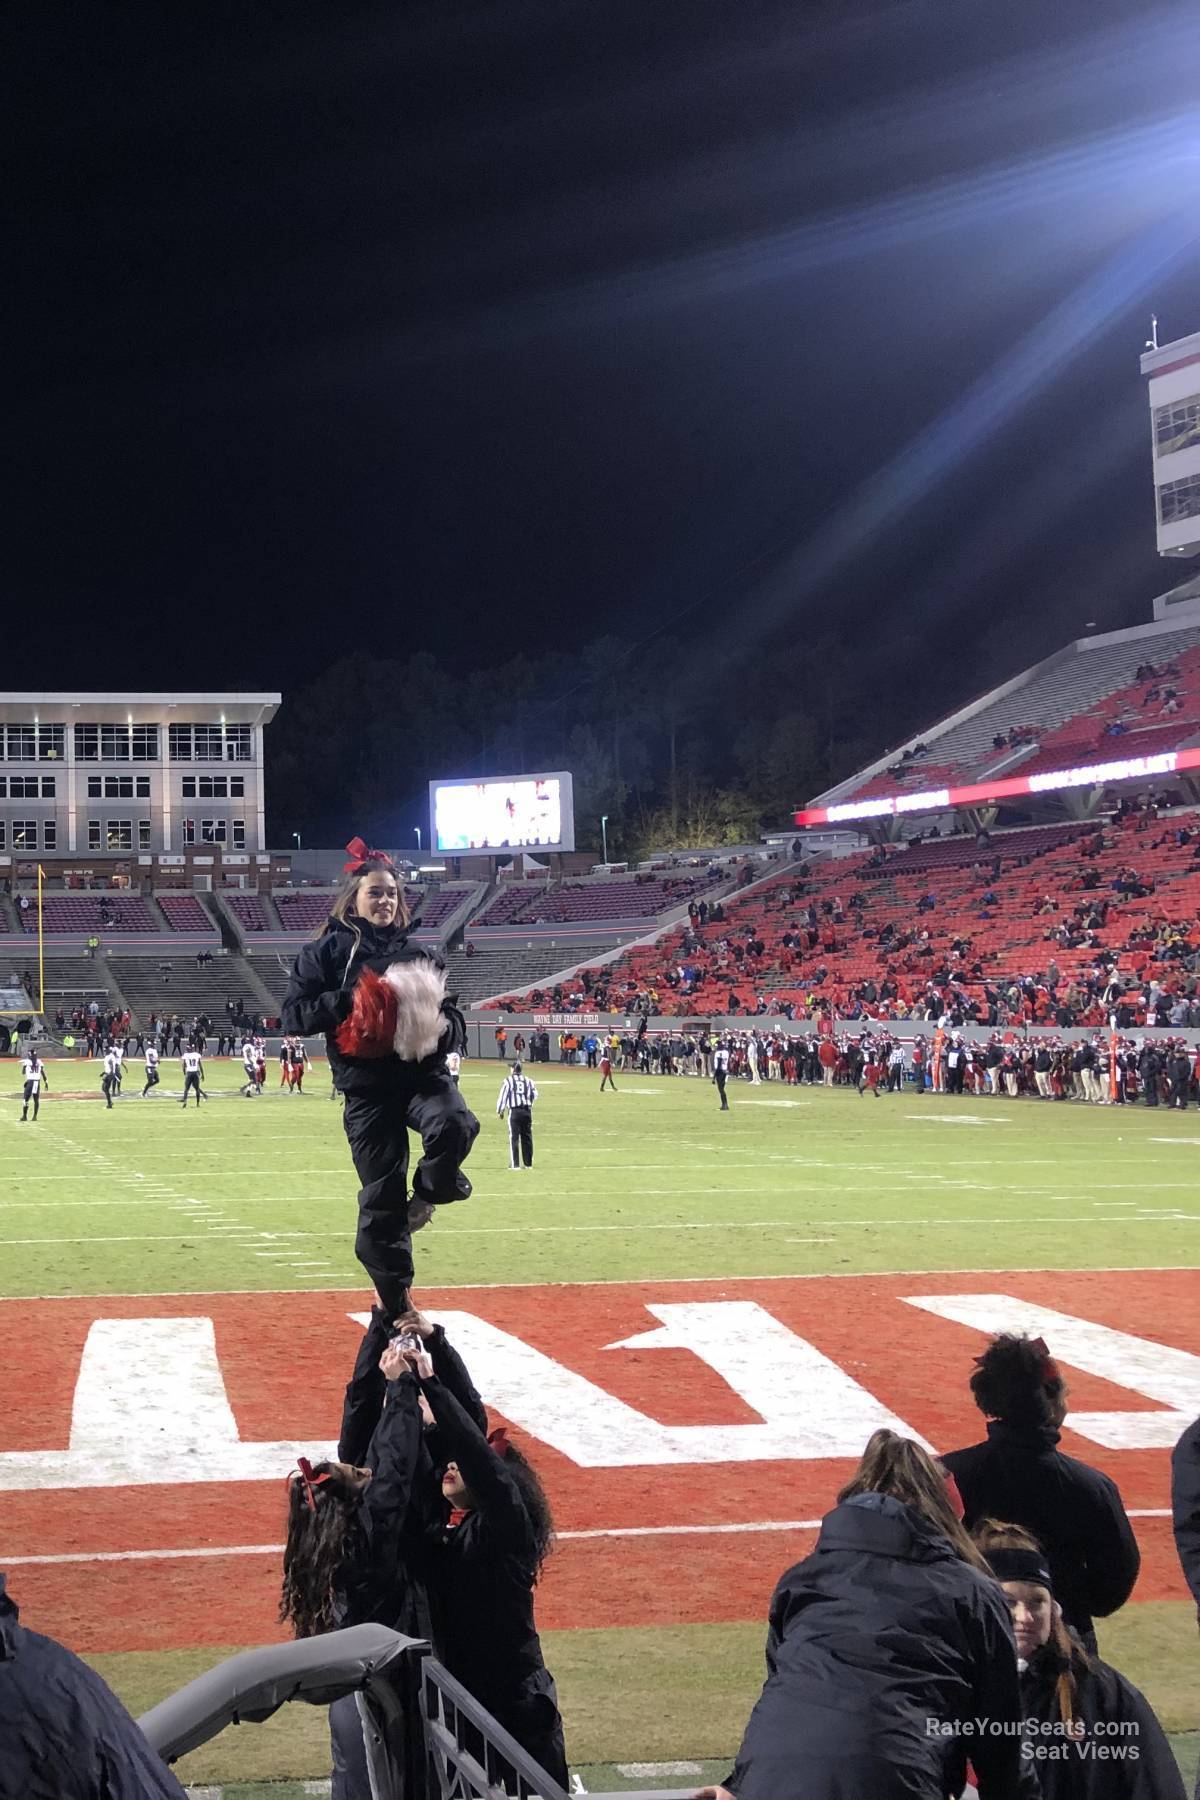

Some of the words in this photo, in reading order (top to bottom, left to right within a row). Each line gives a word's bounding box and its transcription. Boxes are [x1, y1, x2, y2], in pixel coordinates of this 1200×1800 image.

[533, 1014, 551, 1024] WAYNE
[552, 1014, 563, 1024] DAY
[563, 1014, 582, 1024] FAMILY
[583, 1014, 599, 1024] FIELD
